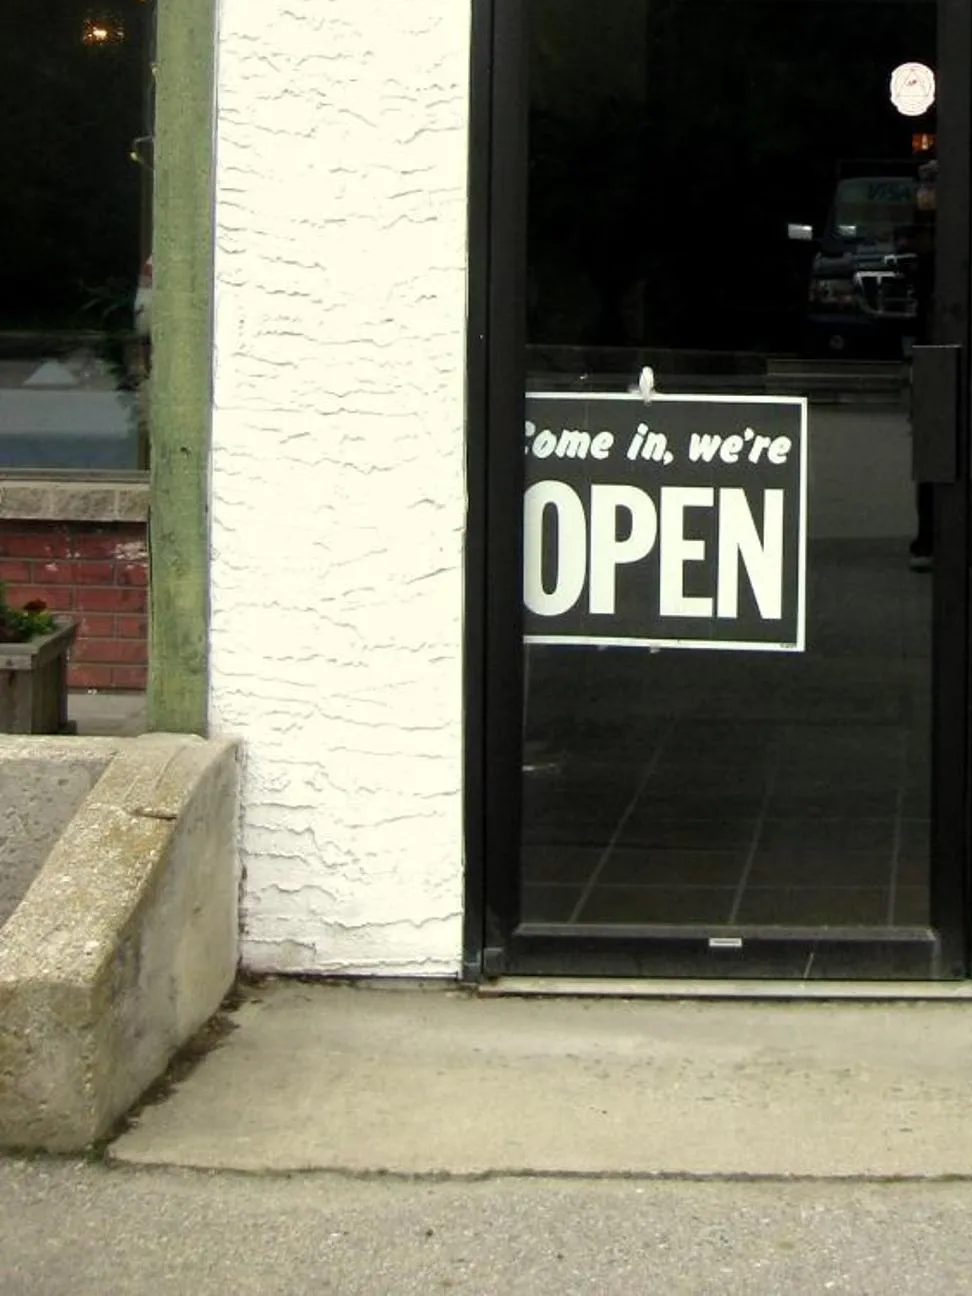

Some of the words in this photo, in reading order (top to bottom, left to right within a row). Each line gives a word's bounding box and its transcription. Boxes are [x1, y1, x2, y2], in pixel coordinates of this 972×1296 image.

[627, 422, 674, 466] in,
[689, 427, 792, 465] we're
[522, 479, 785, 620] OPEN
